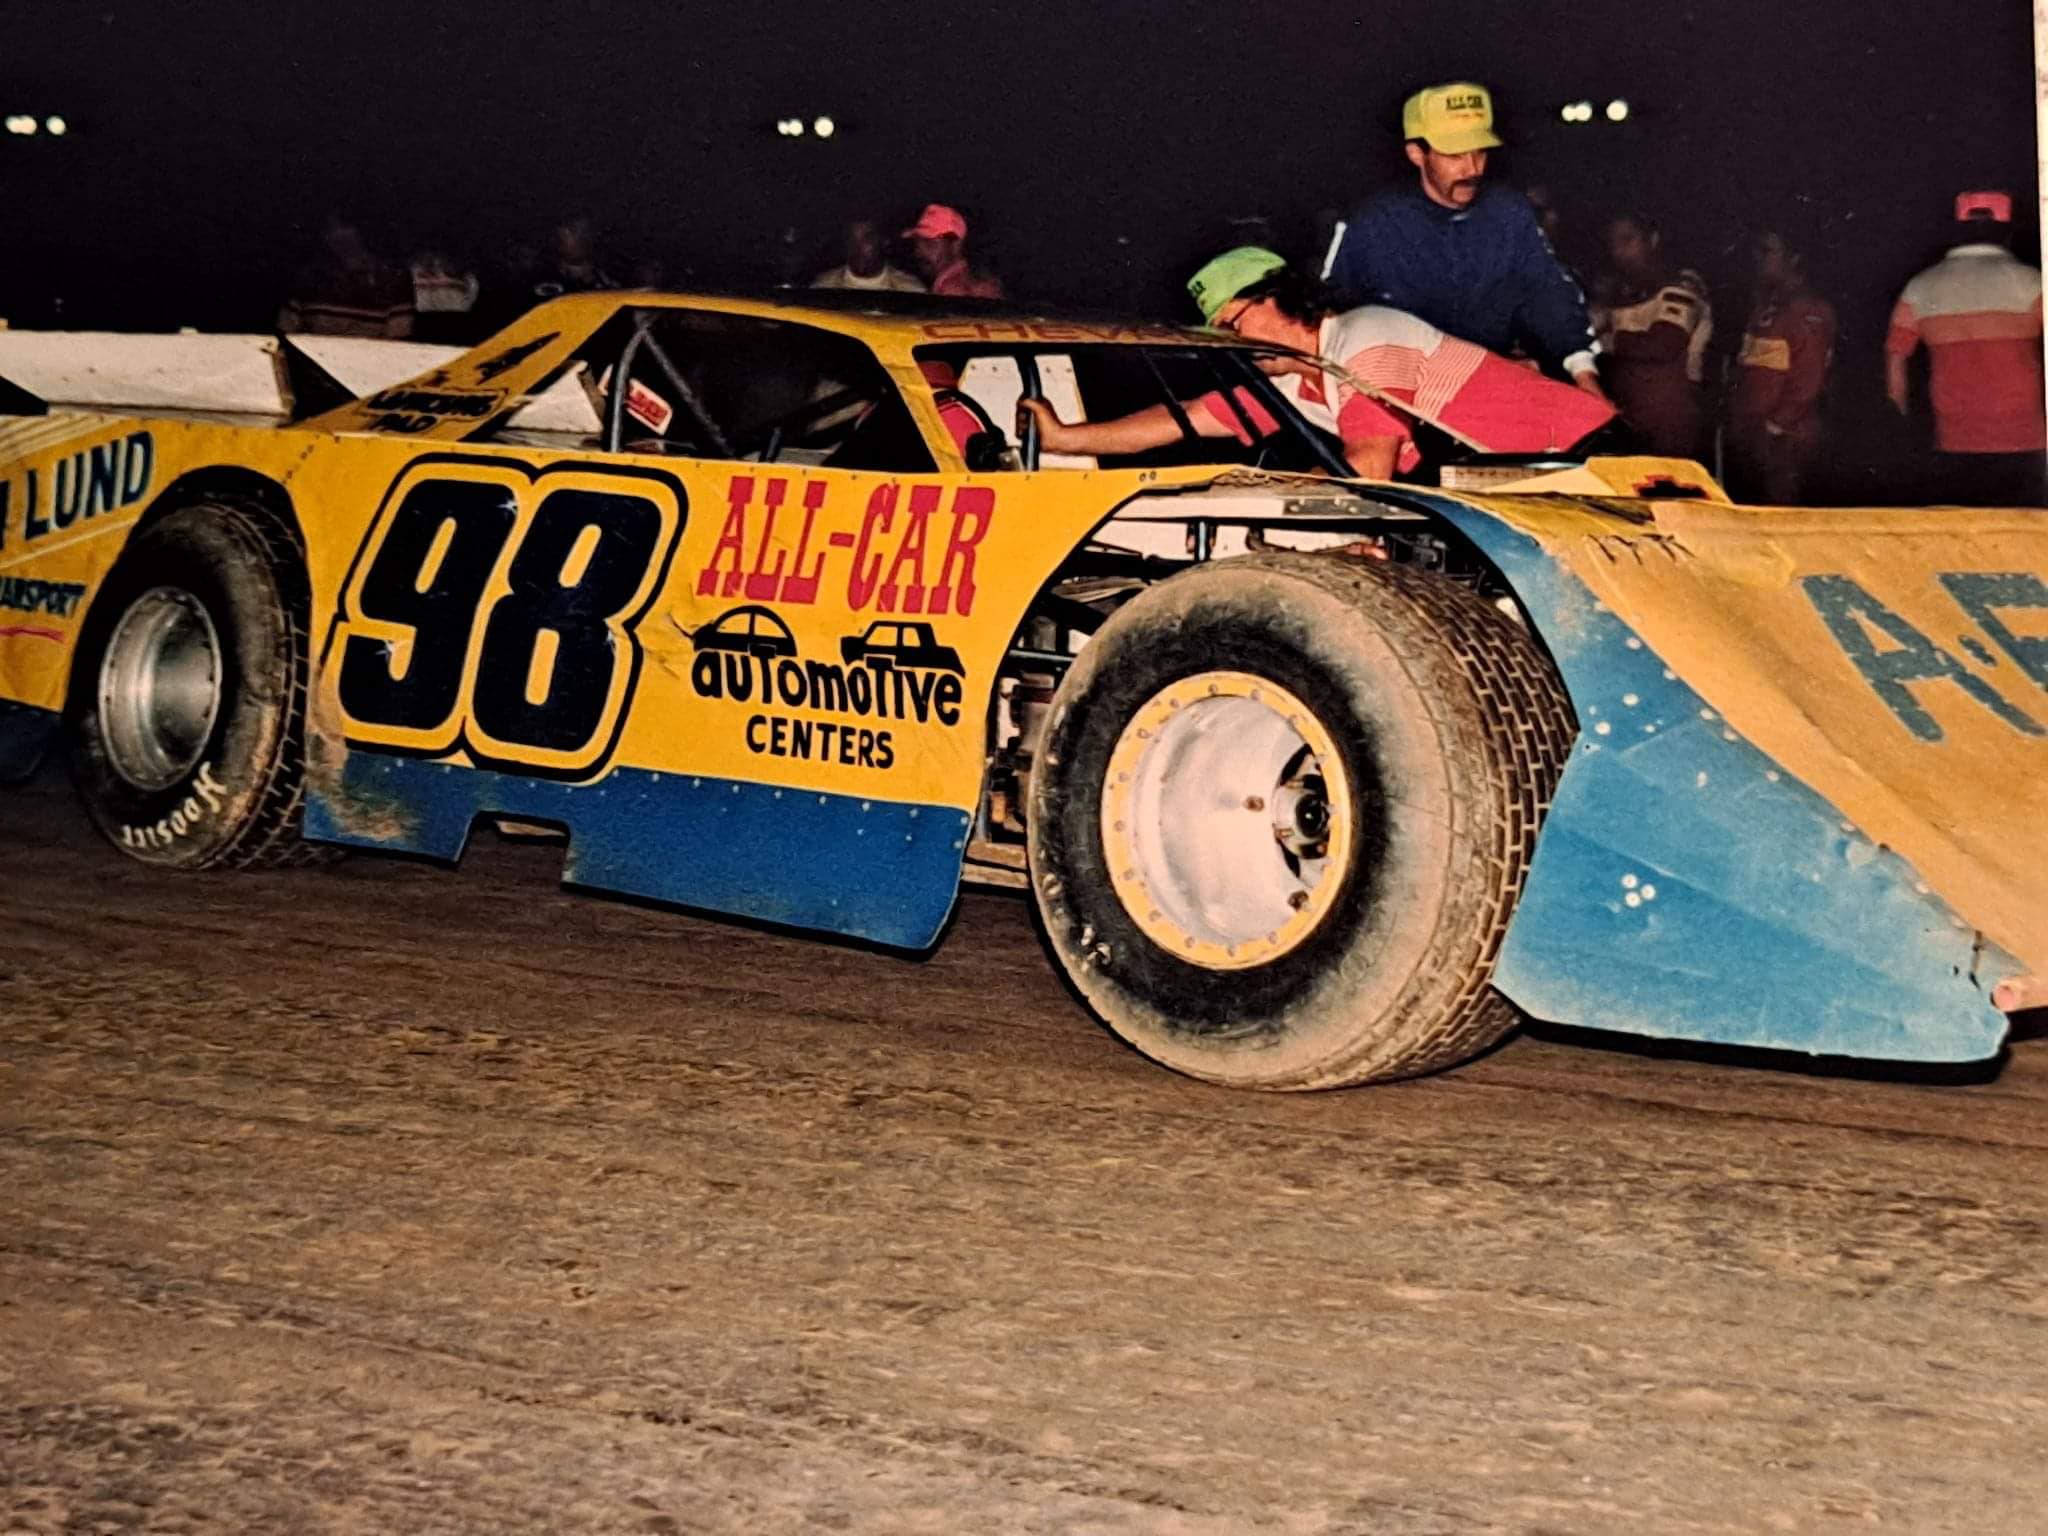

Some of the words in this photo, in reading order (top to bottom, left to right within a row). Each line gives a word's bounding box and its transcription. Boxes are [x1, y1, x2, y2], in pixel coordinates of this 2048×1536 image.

[25, 431, 154, 541] LUND
[696, 475, 996, 617] ALL-CAR
[334, 470, 668, 762] 98
[746, 714, 894, 769] CENTERS
